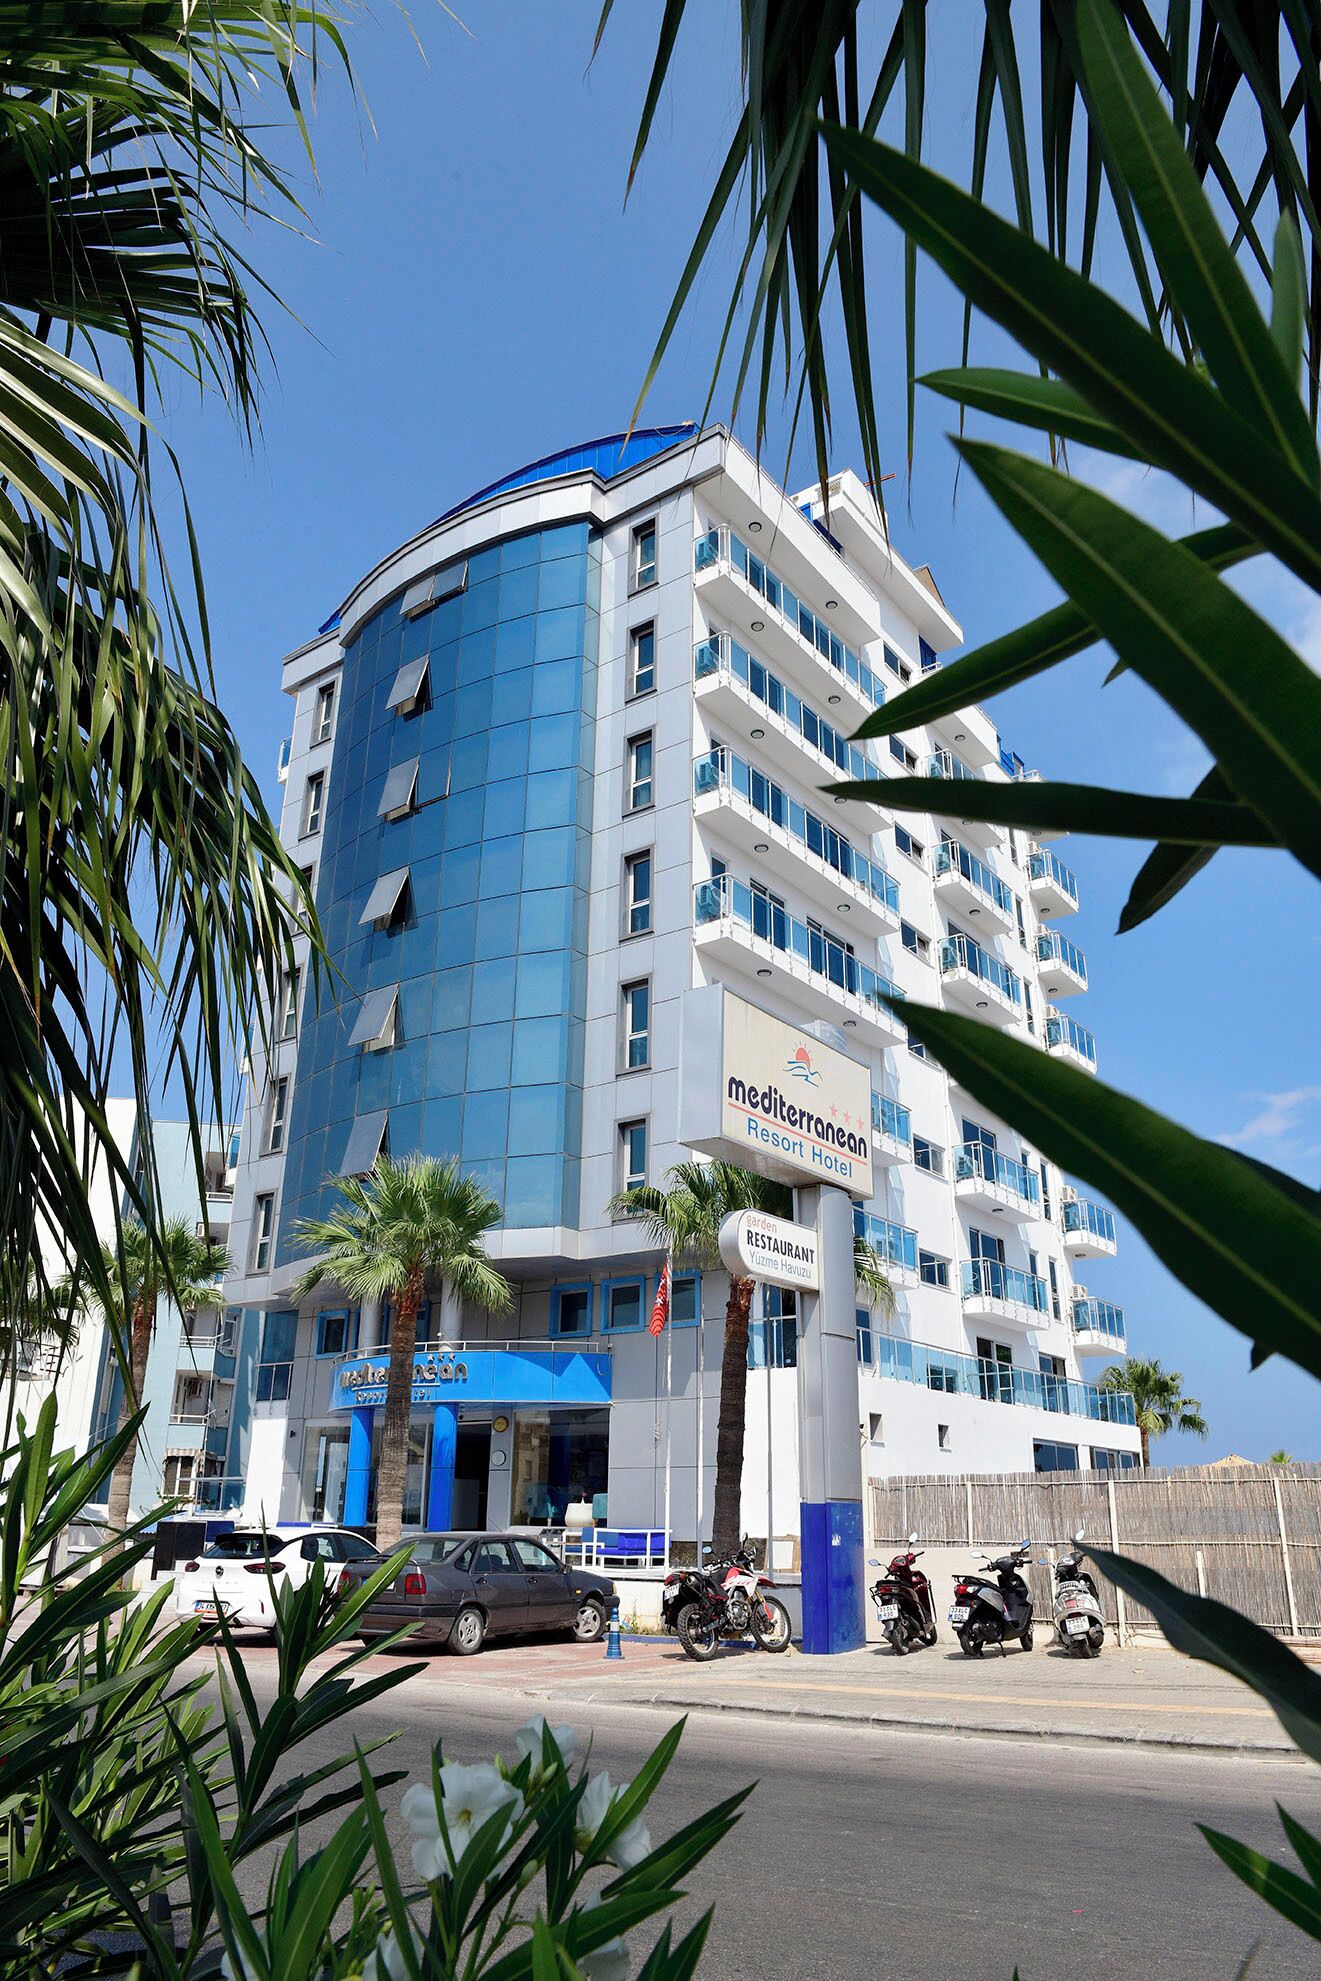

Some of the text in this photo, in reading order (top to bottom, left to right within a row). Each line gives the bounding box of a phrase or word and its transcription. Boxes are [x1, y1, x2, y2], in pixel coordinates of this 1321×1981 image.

[728, 1077, 867, 1159] mediterranean
[747, 1117, 852, 1178] Resort Hotel
[747, 1215, 777, 1233] garden
[747, 1230, 815, 1264] RESTAURANT
[749, 1249, 811, 1279] Yüzme Havuzu
